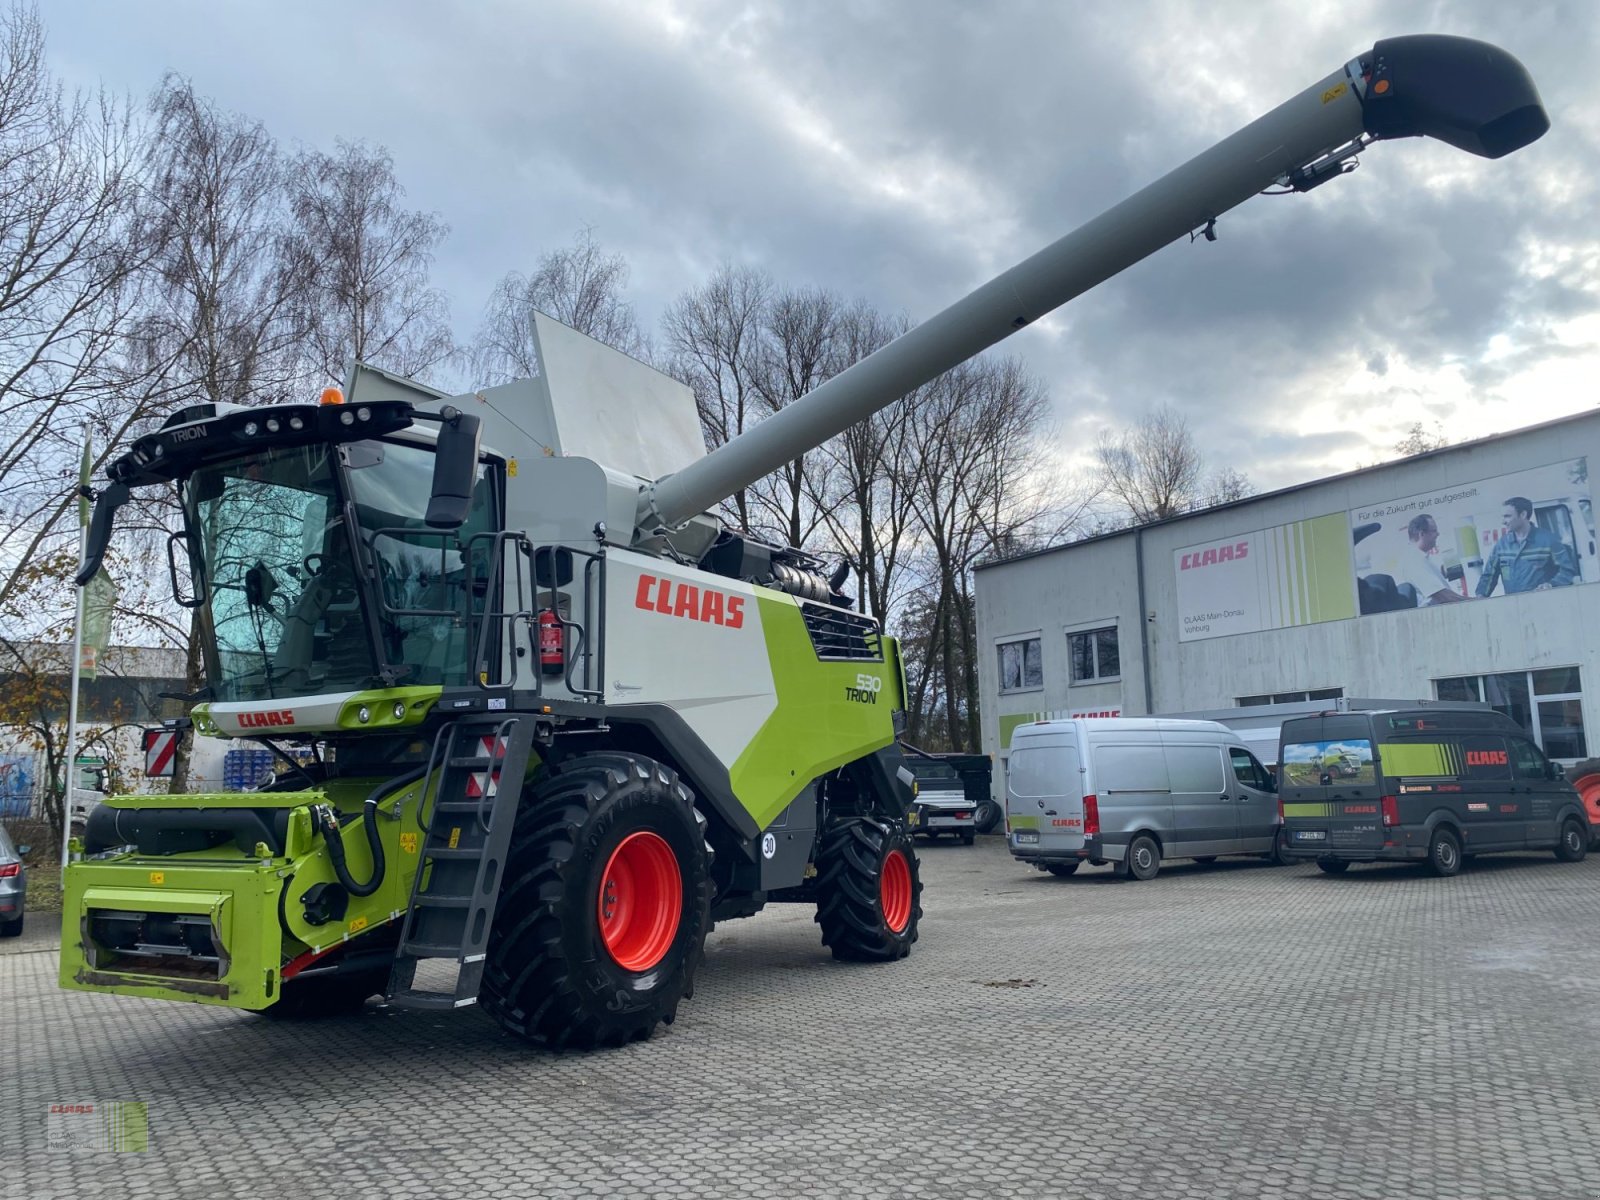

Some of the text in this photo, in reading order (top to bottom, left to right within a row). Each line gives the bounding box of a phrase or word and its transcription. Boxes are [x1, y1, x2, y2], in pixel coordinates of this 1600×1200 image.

[170, 424, 208, 443] TRION
[1358, 511, 1371, 521] Für
[1372, 509, 1385, 518] die
[1386, 501, 1416, 516] Zukunft
[1418, 498, 1432, 510] gut
[1180, 541, 1249, 572] CLAAS
[635, 574, 745, 629] CLAAS
[1183, 609, 1245, 625] CLAAS Main-Donau
[1184, 624, 1210, 634] Vohburg
[856, 673, 882, 693] 530
[845, 686, 877, 704] TRION
[237, 709, 295, 728] CLAAS
[1467, 751, 1507, 765] CLAAS
[1052, 819, 1081, 827] CLAAS
[764, 837, 774, 854] 30
